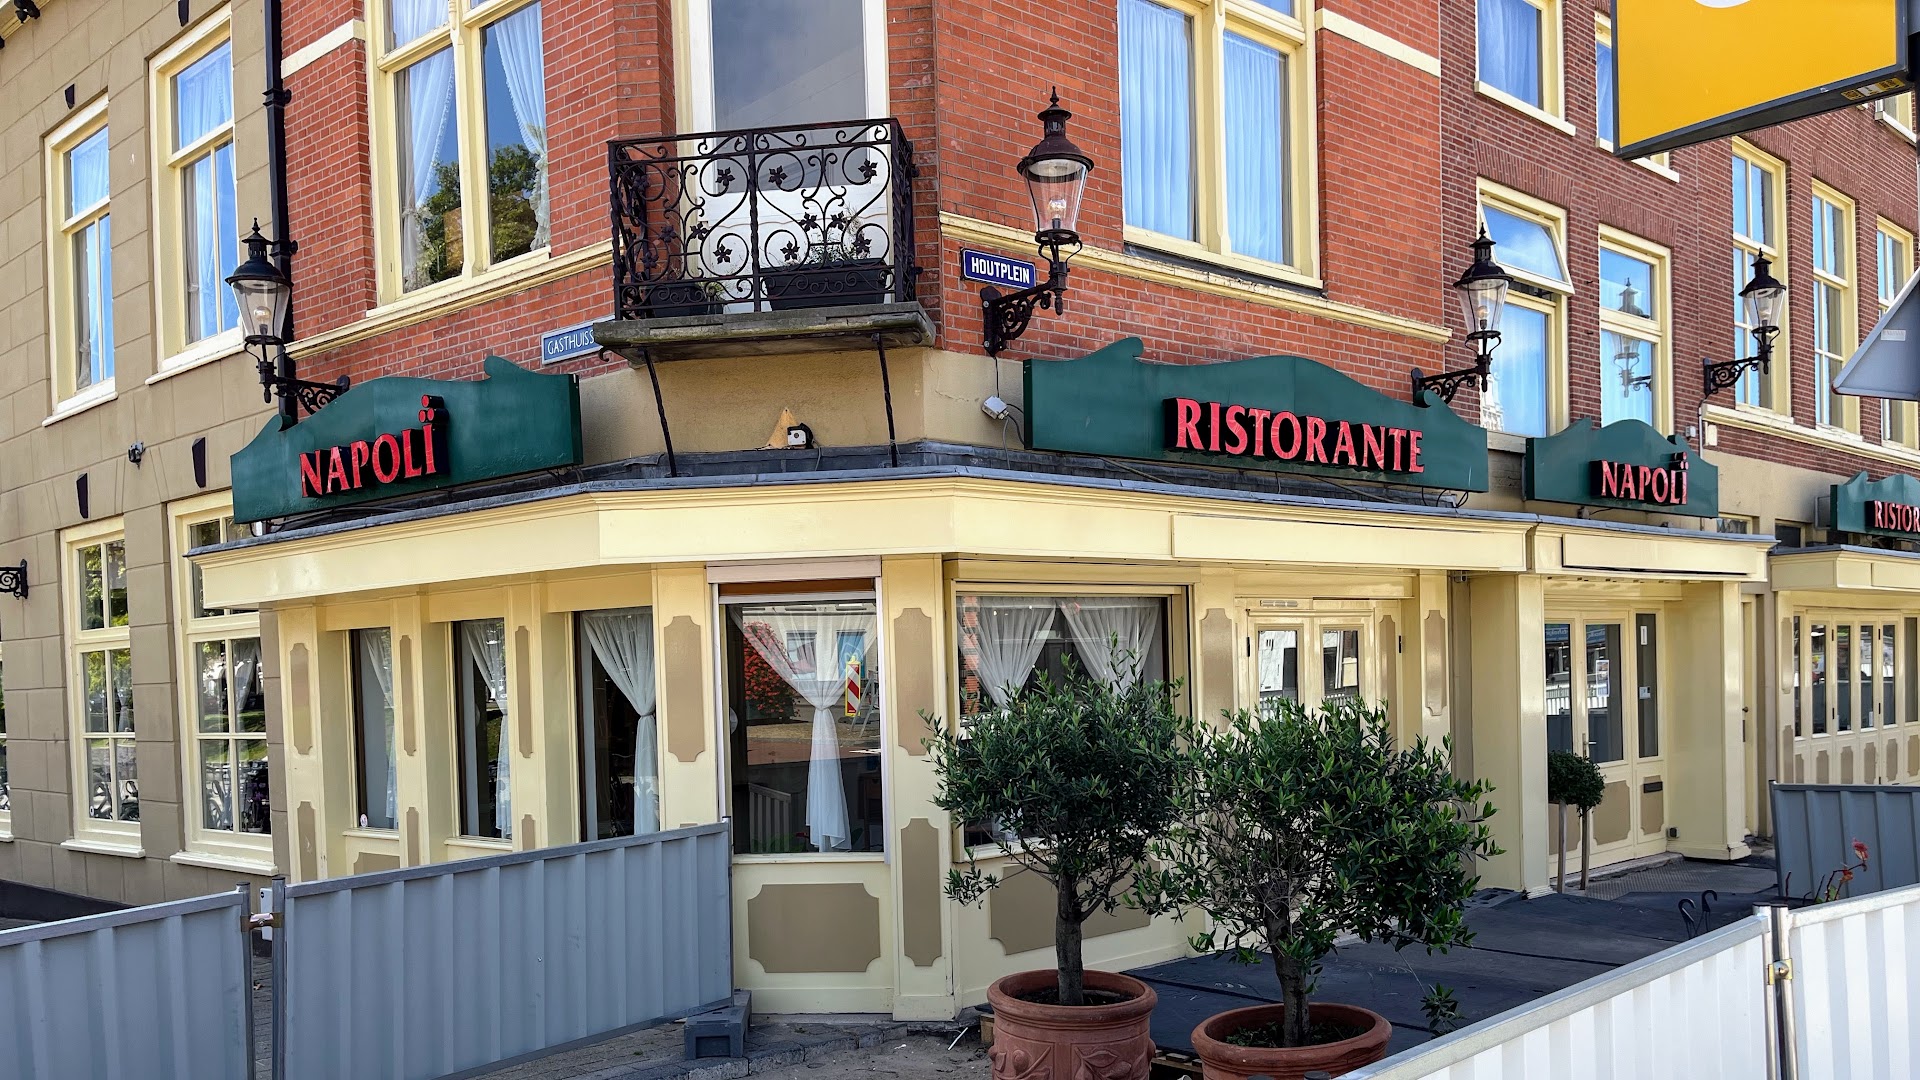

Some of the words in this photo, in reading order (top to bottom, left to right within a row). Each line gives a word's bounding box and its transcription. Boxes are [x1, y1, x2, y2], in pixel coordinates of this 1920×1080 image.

[971, 256, 1030, 284] HOUTPLEIN
[1176, 397, 1425, 473] RISTORANTE
[1874, 500, 1920, 533] RISTOR
